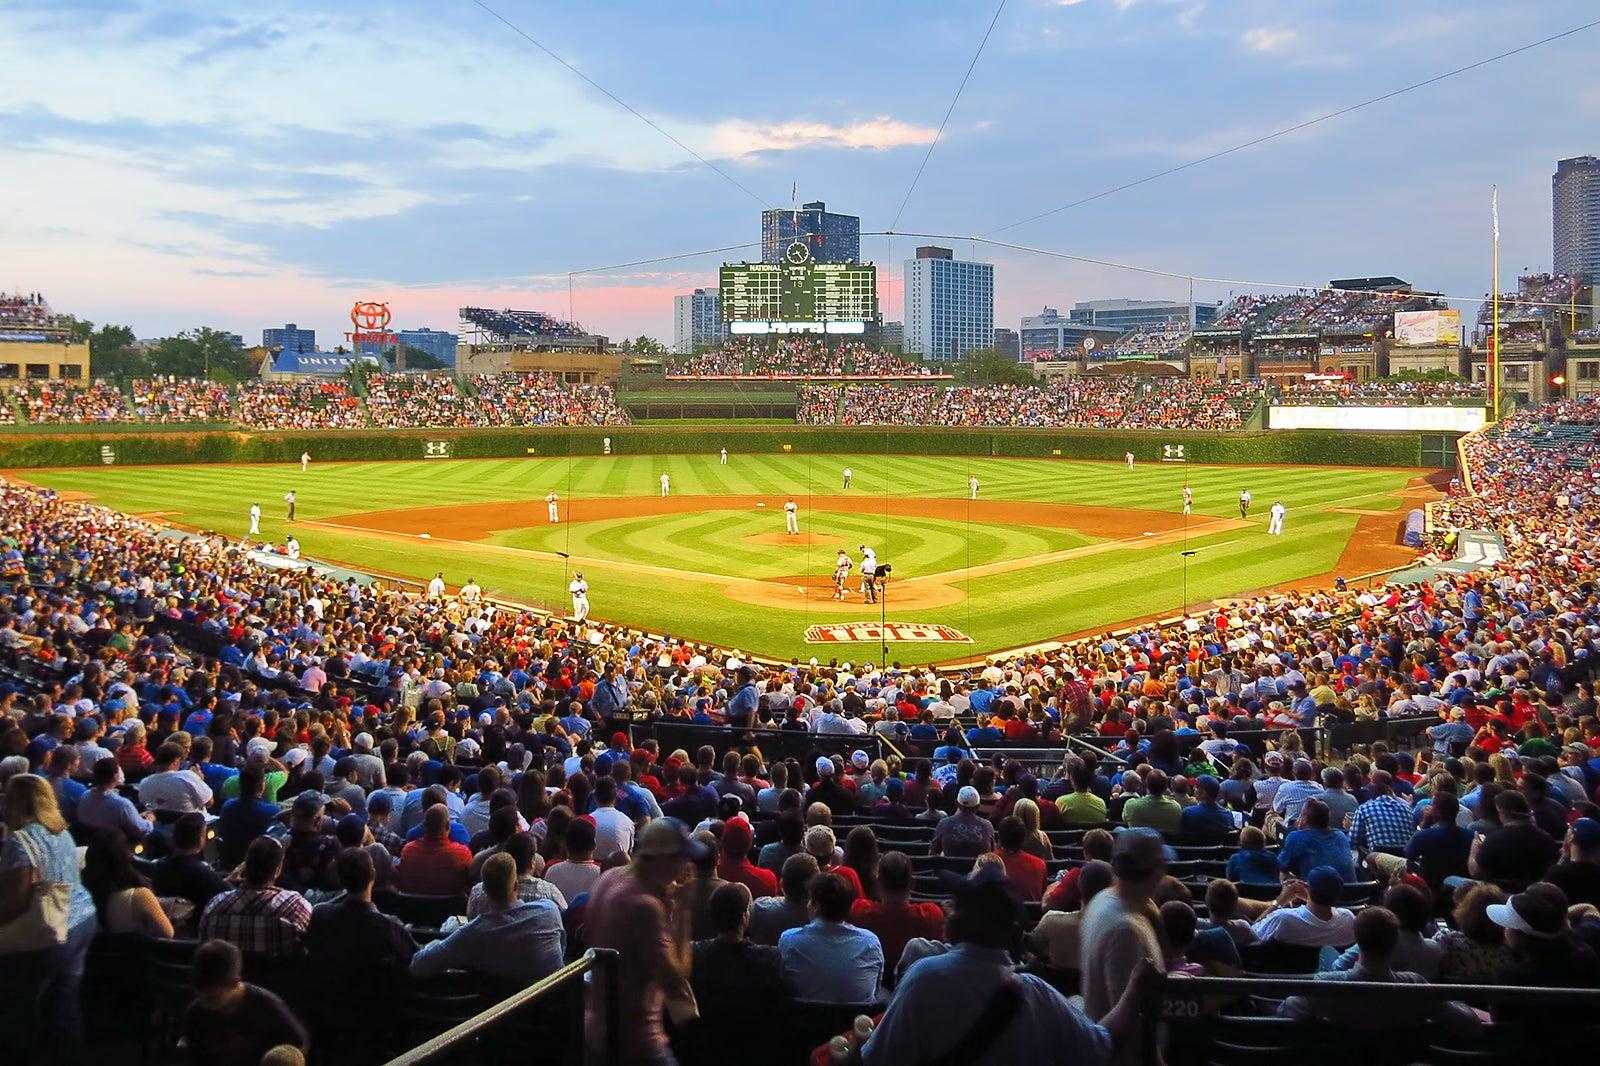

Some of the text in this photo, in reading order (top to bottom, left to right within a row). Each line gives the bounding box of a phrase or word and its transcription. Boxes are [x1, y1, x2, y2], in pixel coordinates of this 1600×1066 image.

[749, 264, 782, 272] NATIONAL
[344, 332, 399, 344] TOYOTA
[827, 628, 945, 640] 100
[1161, 1000, 1199, 1017] 220
